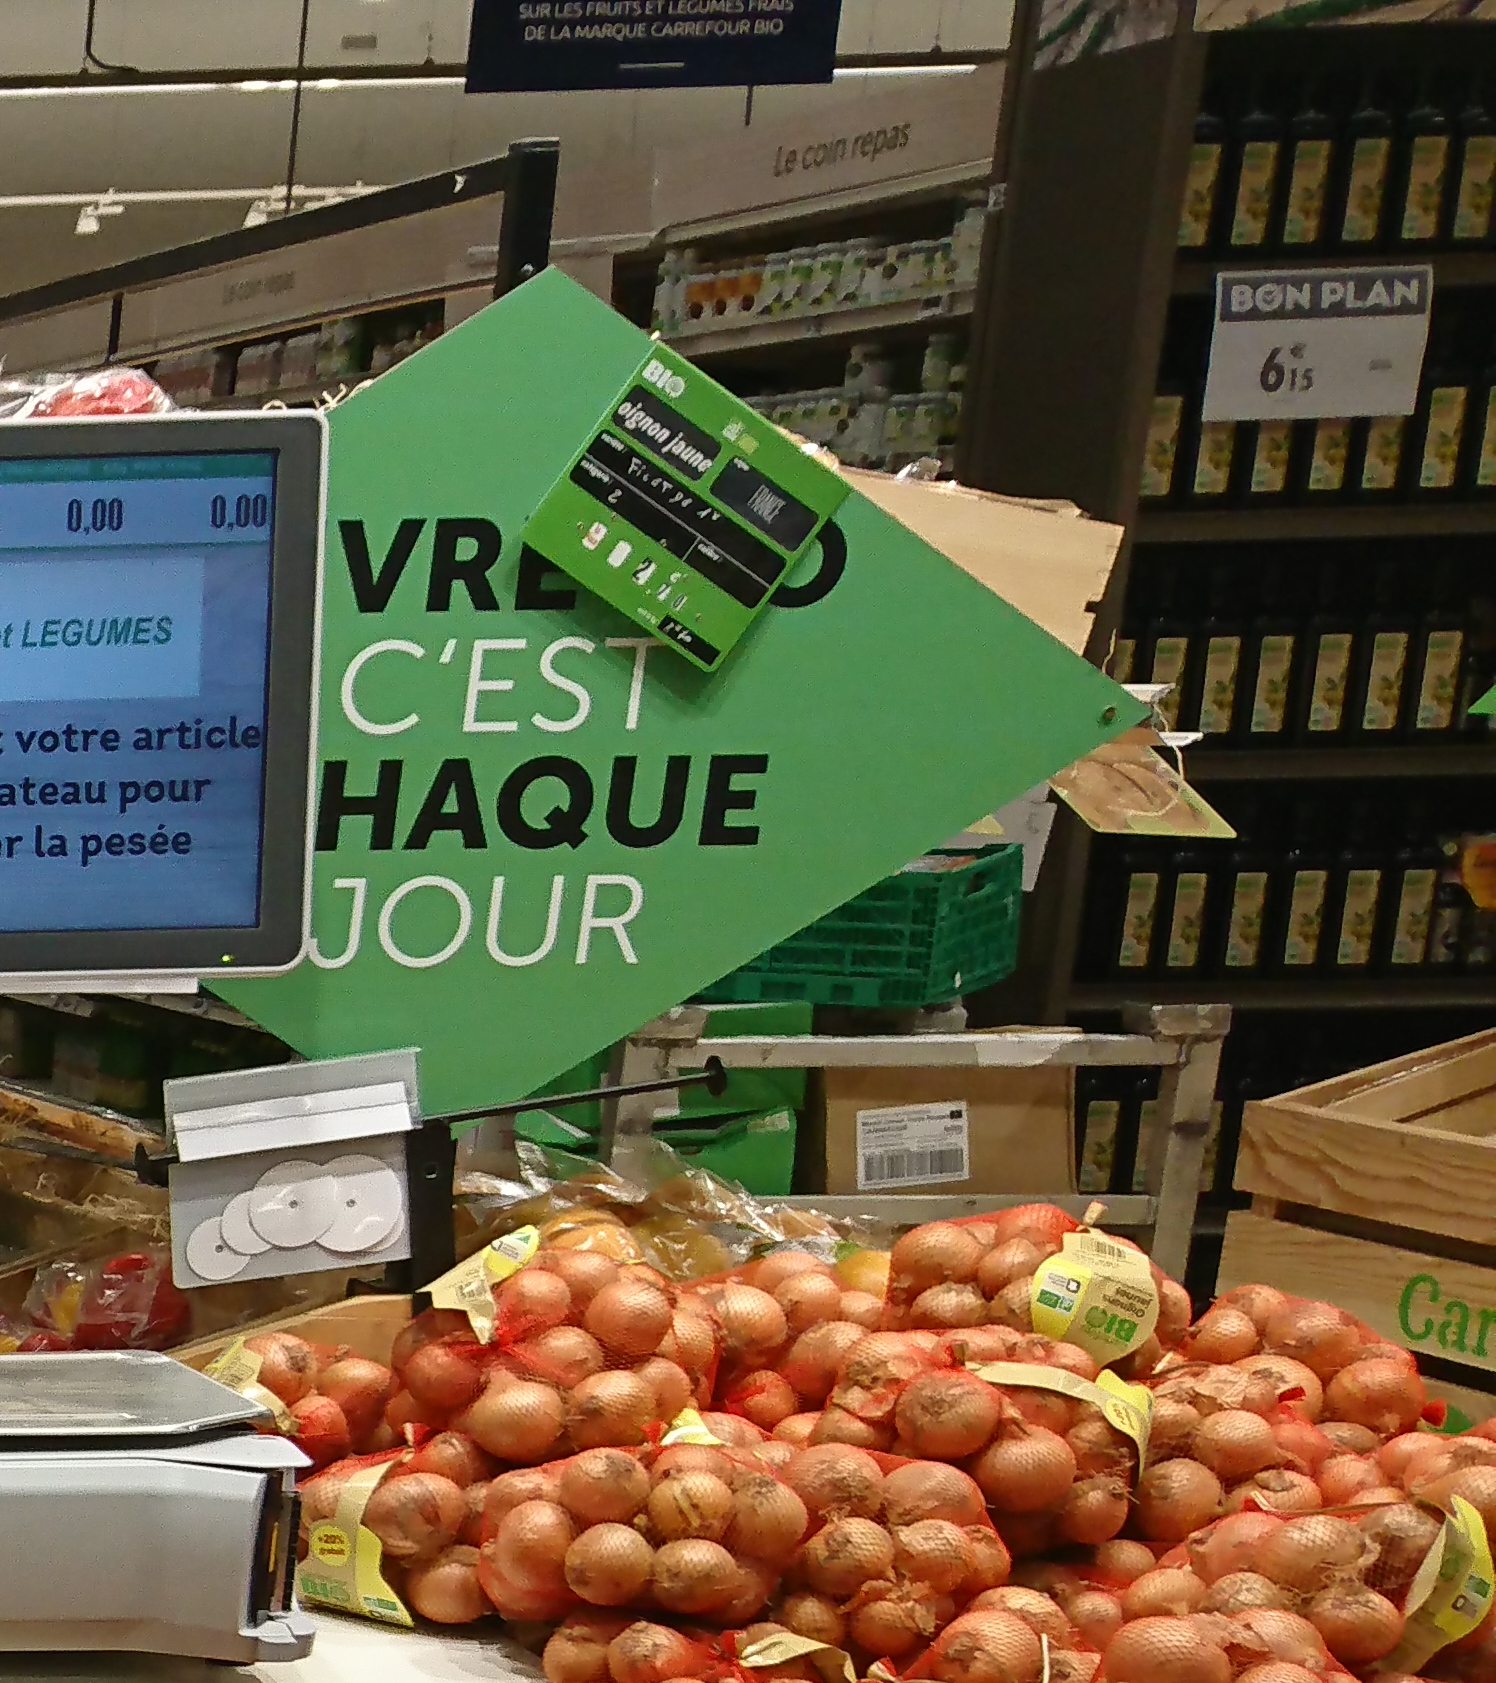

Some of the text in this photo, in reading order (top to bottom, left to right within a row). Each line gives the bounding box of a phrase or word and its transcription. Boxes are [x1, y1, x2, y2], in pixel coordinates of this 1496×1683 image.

[519, 2, 551, 19] SUR
[524, 18, 784, 41] DE LA MARQUE CARREFOUR BIO
[851, 123, 911, 162] repas
[1230, 278, 1420, 313] BON PLAN
[641, 358, 687, 399] BIO
[617, 400, 714, 474] oignon jaune
[66, 497, 124, 536] 0,00
[210, 493, 268, 532] 0,00
[21, 615, 173, 649] LEGUMES
[341, 637, 666, 736] C'EST
[16, 724, 119, 755] votre
[133, 715, 262, 752] article
[119, 774, 211, 813] pour
[35, 825, 68, 859] la
[81, 824, 193, 868] pesée
[310, 874, 645, 968] JOUR
[1084, 1305, 1139, 1343] BIO
[1398, 1273, 1496, 1358] Car
